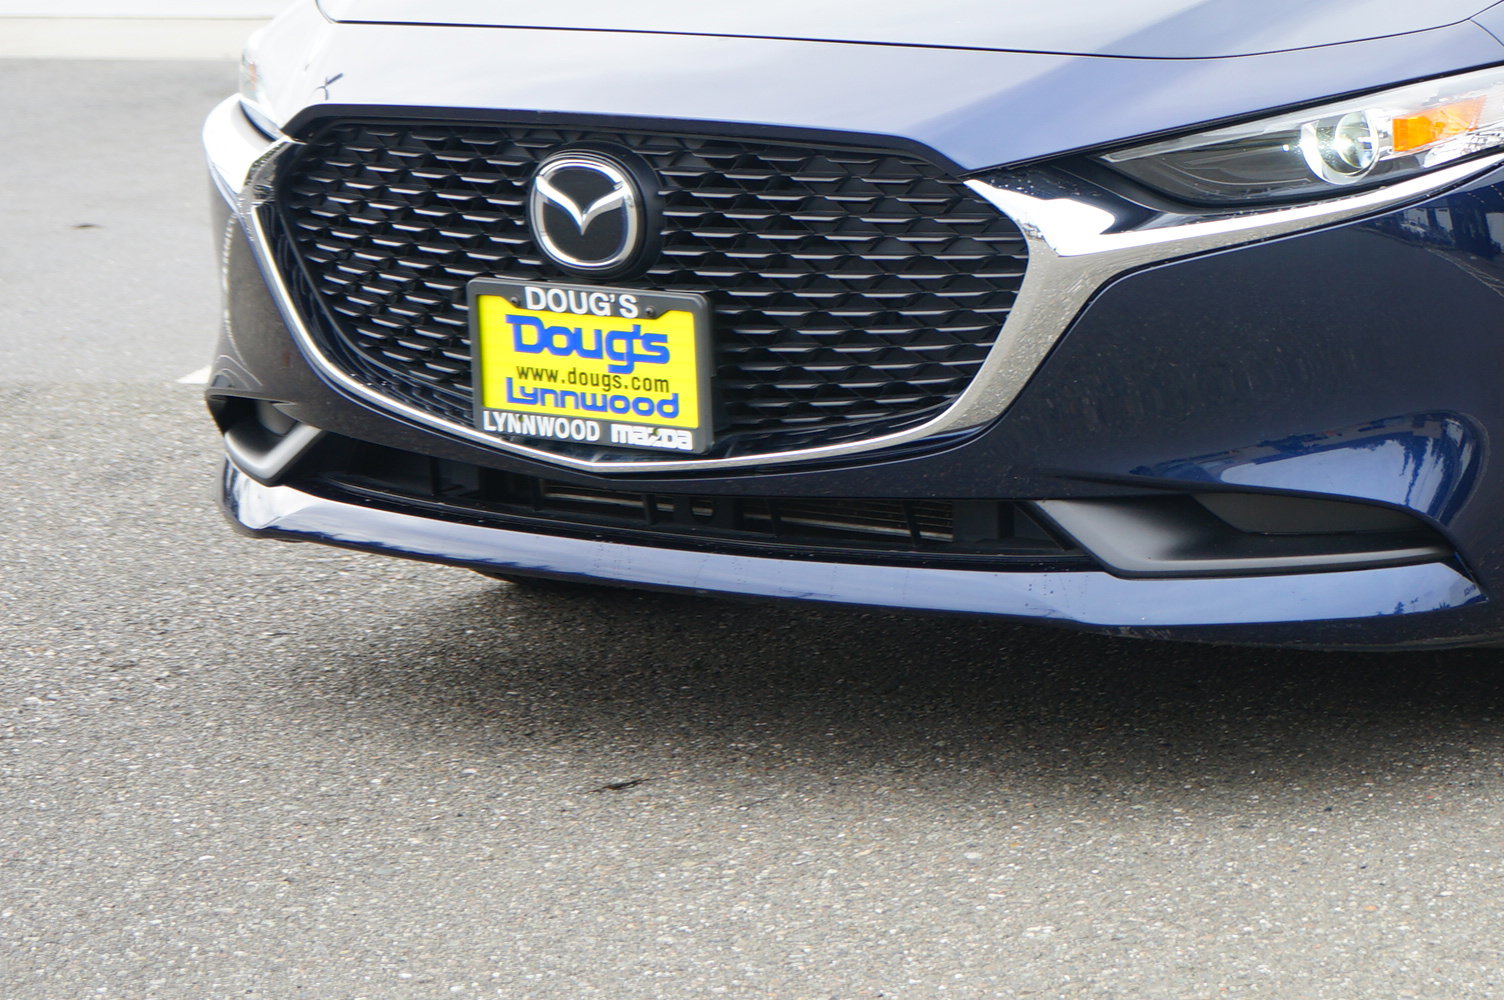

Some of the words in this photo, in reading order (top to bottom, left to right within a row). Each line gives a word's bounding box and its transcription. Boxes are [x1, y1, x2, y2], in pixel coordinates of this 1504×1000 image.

[524, 286, 639, 319] DOUG'S
[505, 313, 671, 375] Doug's
[516, 365, 670, 394] www.dougs.com
[505, 376, 680, 419] Lynnwood
[482, 410, 600, 442] LYNNWOOD
